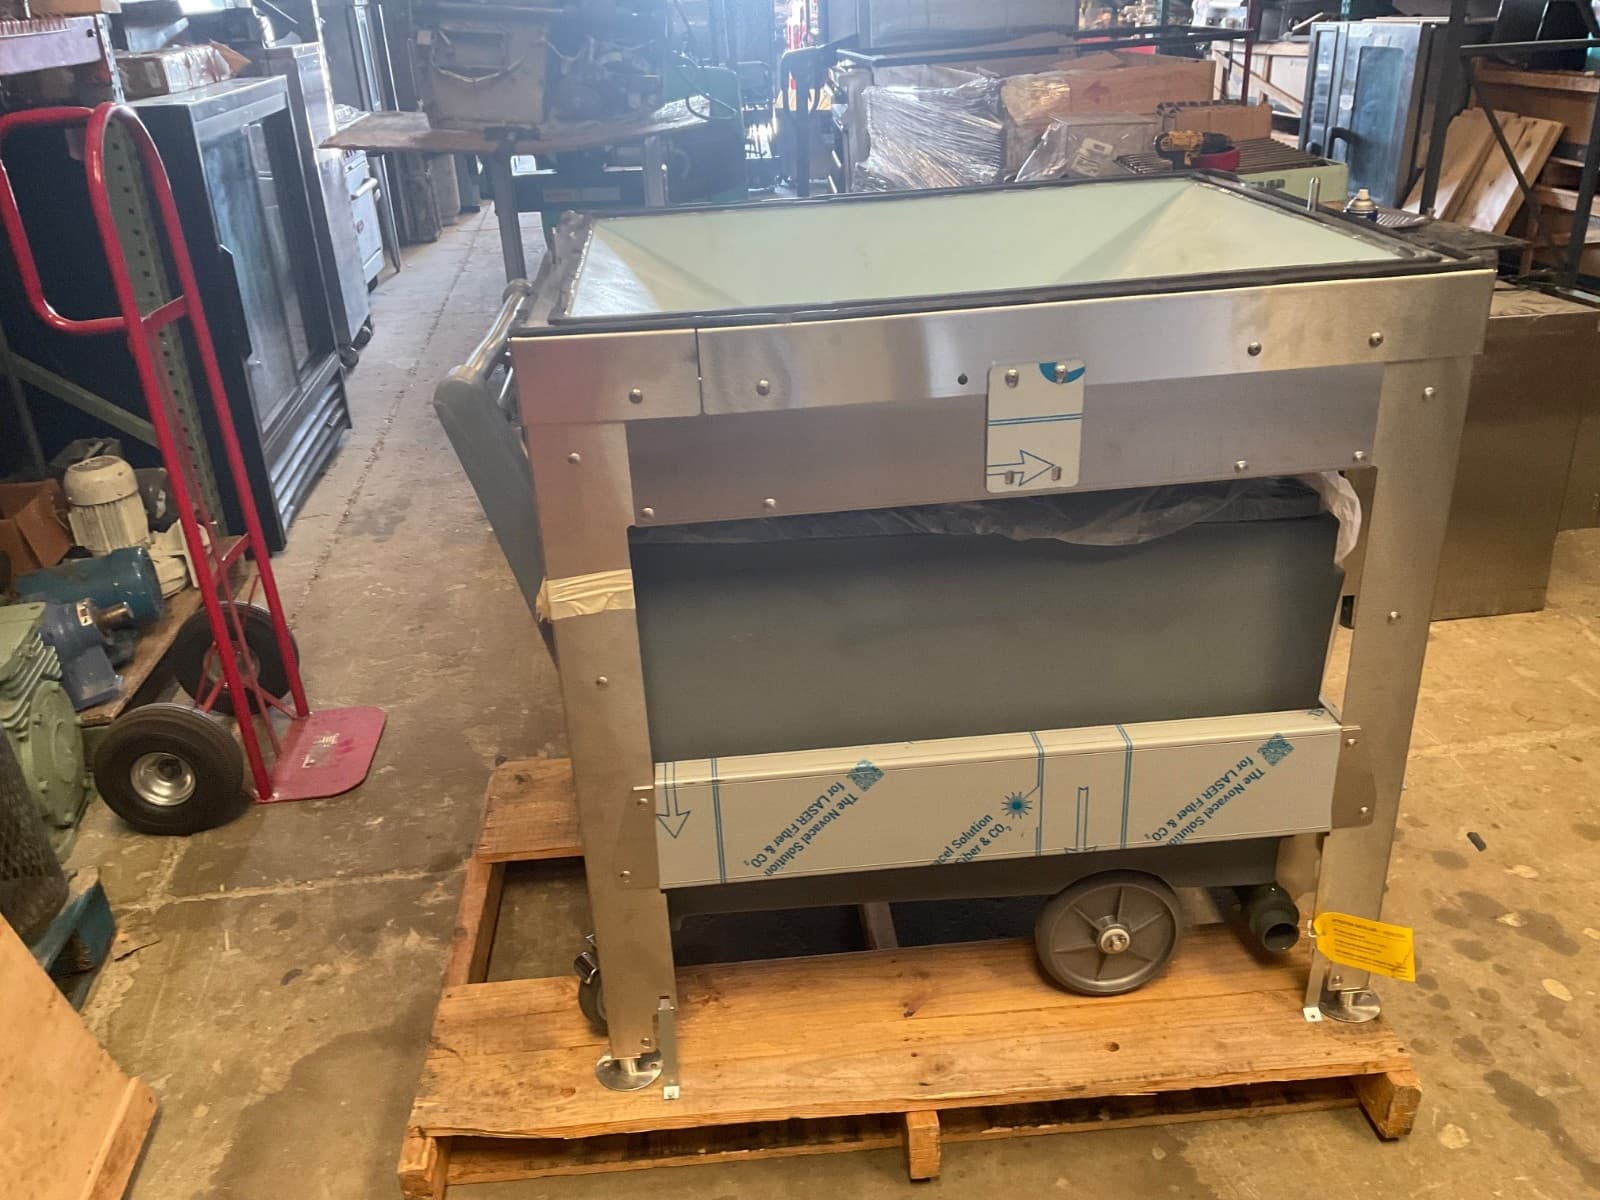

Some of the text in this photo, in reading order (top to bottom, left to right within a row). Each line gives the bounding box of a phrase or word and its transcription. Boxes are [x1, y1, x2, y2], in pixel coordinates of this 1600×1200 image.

[1236, 756, 1254, 771] for
[1201, 769, 1238, 800] LASER
[1242, 768, 1266, 784] The
[827, 781, 845, 797] for
[795, 795, 831, 825] LASER
[836, 793, 859, 810] The
[1176, 797, 1204, 820] Fiber
[1203, 783, 1246, 819] Novacel
[800, 809, 841, 845] Novacel
[951, 814, 993, 849] Solution
[1166, 819, 1177, 828] &
[773, 823, 800, 846] Fiber
[980, 837, 991, 846] &
[764, 845, 776, 854] &
